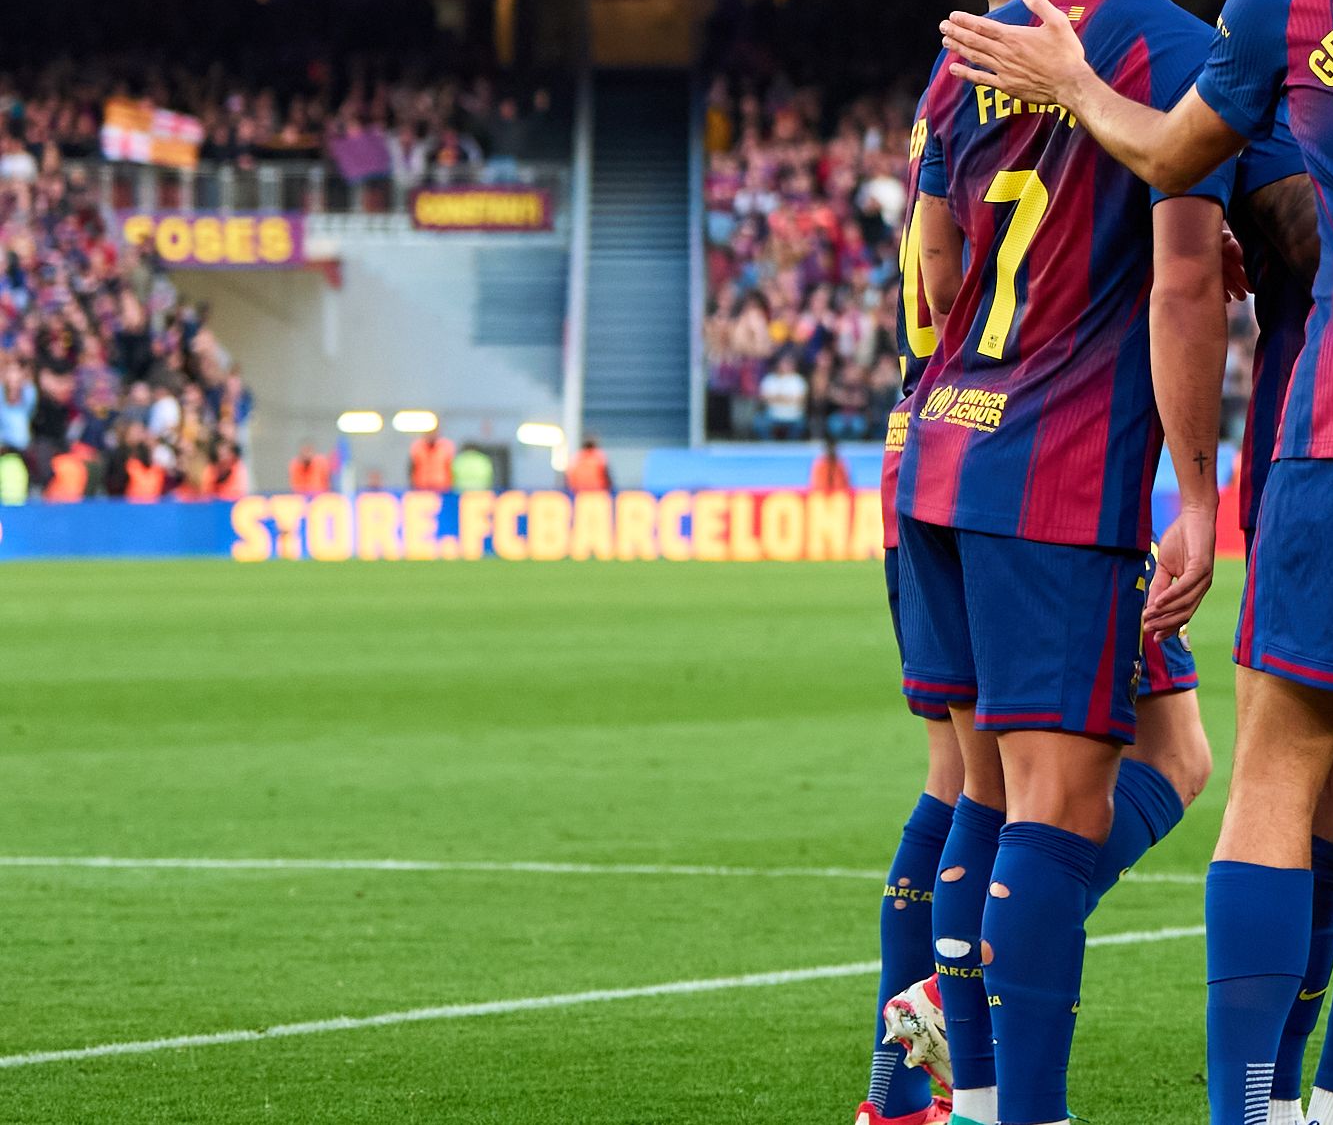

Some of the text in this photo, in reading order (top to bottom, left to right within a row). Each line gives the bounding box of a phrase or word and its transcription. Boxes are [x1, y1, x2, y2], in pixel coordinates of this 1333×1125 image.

[976, 169, 1050, 360] 7
[957, 388, 1008, 411] UNHCR
[945, 402, 1003, 428] ACNUR
